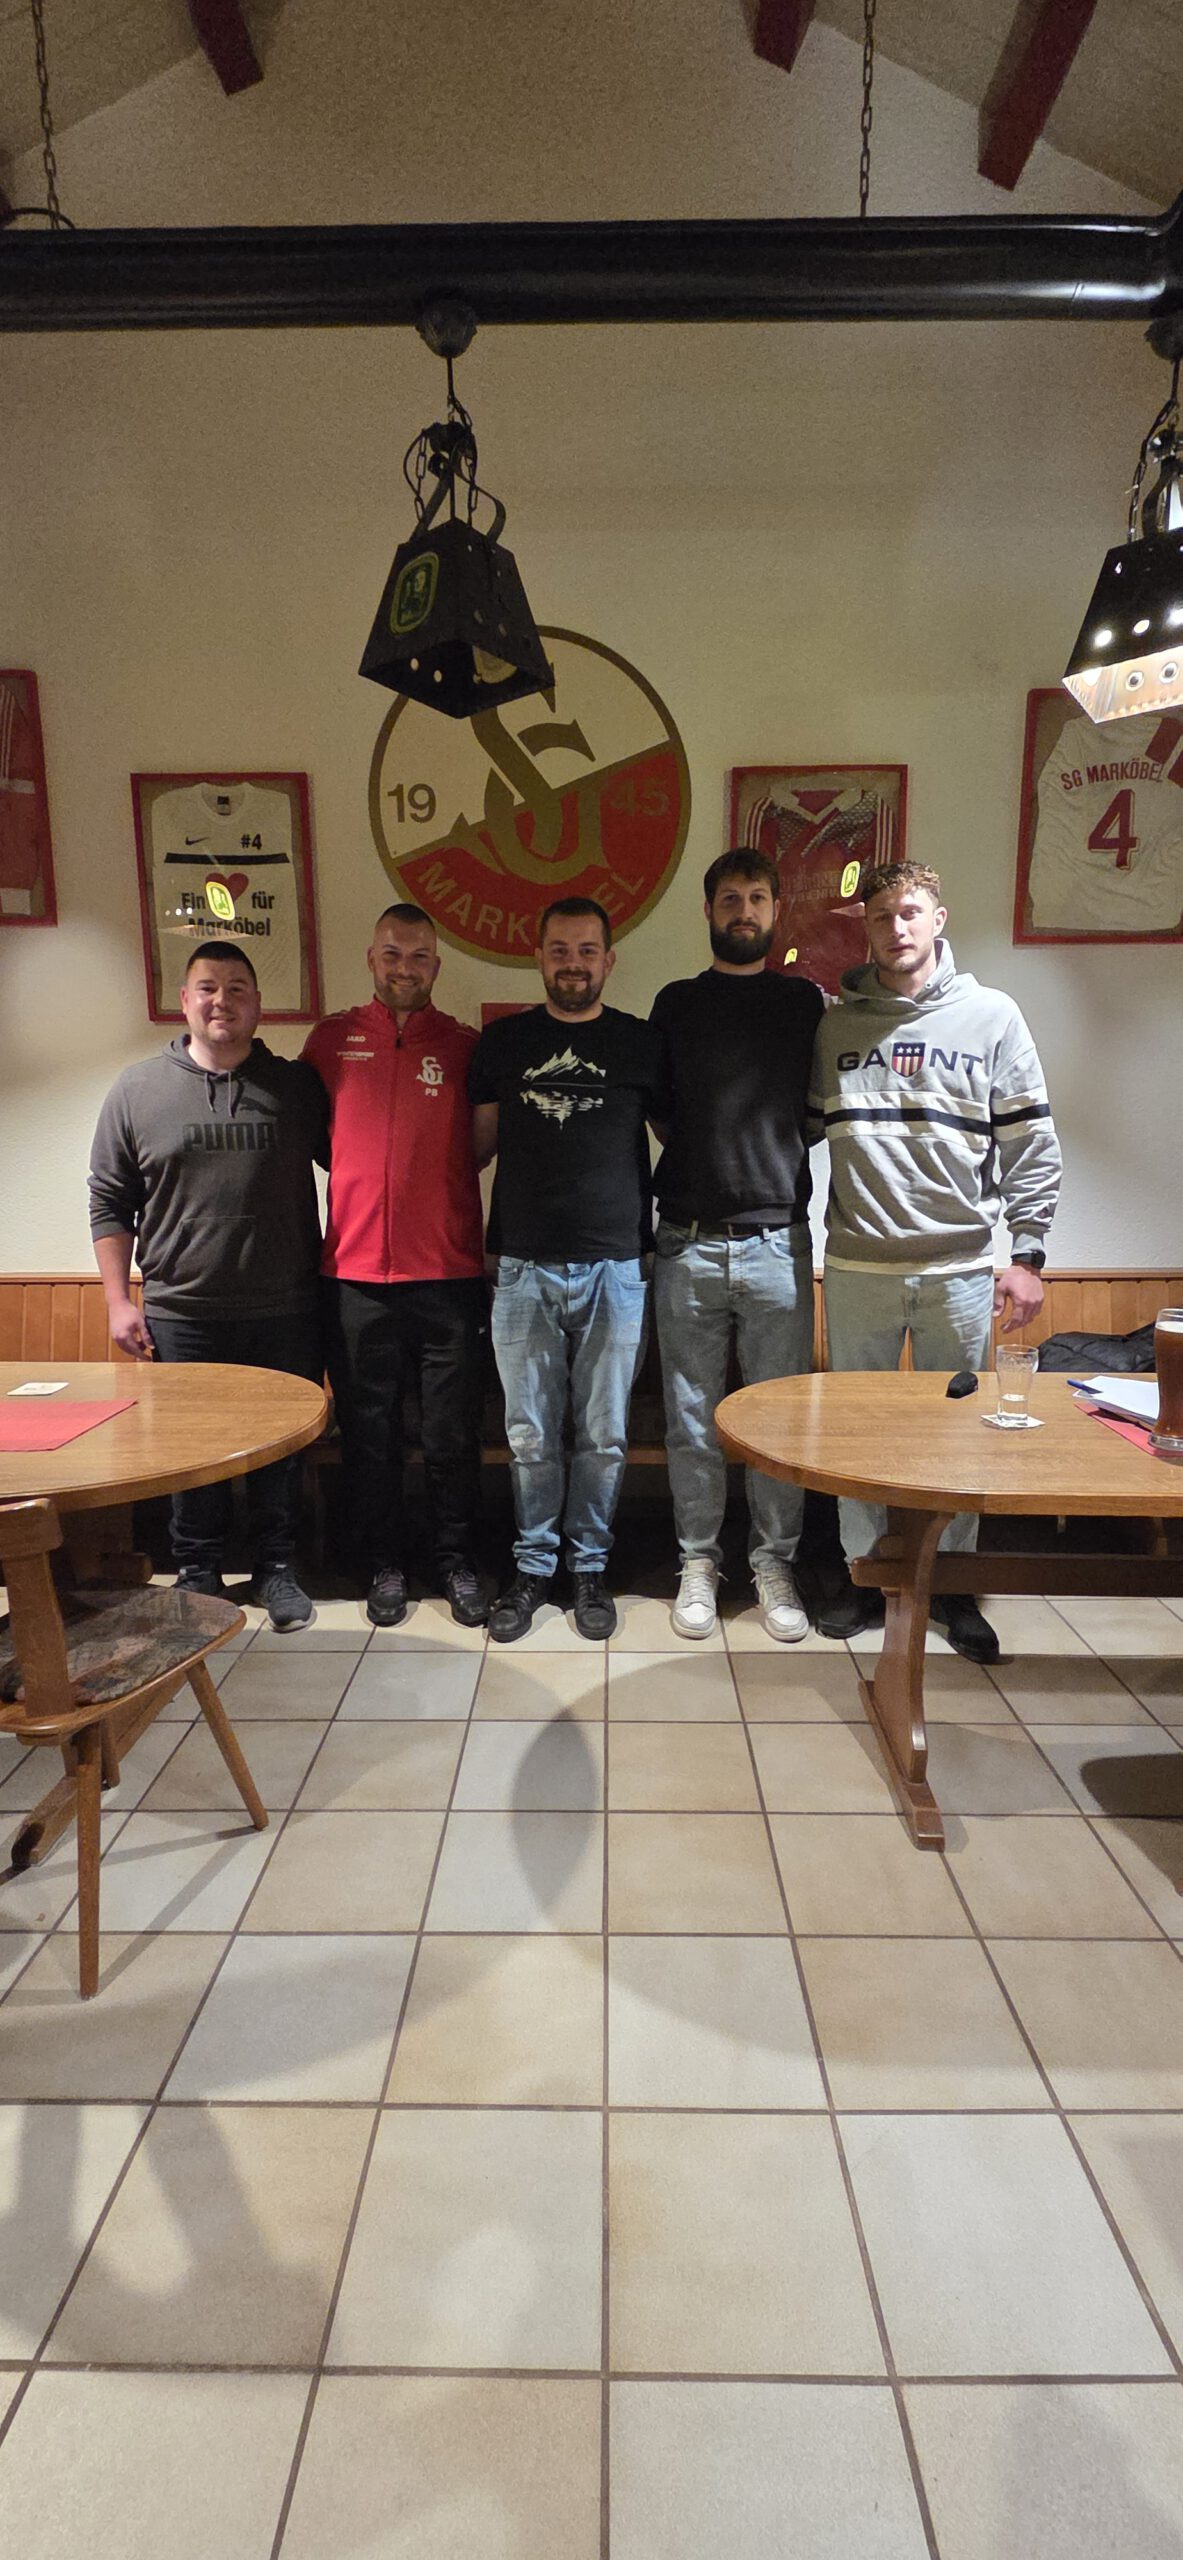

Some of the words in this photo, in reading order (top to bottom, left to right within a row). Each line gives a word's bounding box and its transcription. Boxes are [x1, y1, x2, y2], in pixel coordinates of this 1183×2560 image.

[1060, 769, 1082, 790] SG
[1085, 757, 1163, 783] MARKÖBEL
[387, 783, 437, 824] 19
[610, 777, 670, 818] 45
[240, 833, 263, 850] #4
[1087, 788, 1140, 870] 4
[181, 892, 206, 910] Ein
[251, 891, 275, 910] für
[417, 860, 645, 946] MARKEL
[188, 917, 271, 937] Marköbel
[425, 1088, 438, 1097] PB
[182, 1123, 275, 1153] PUMA
